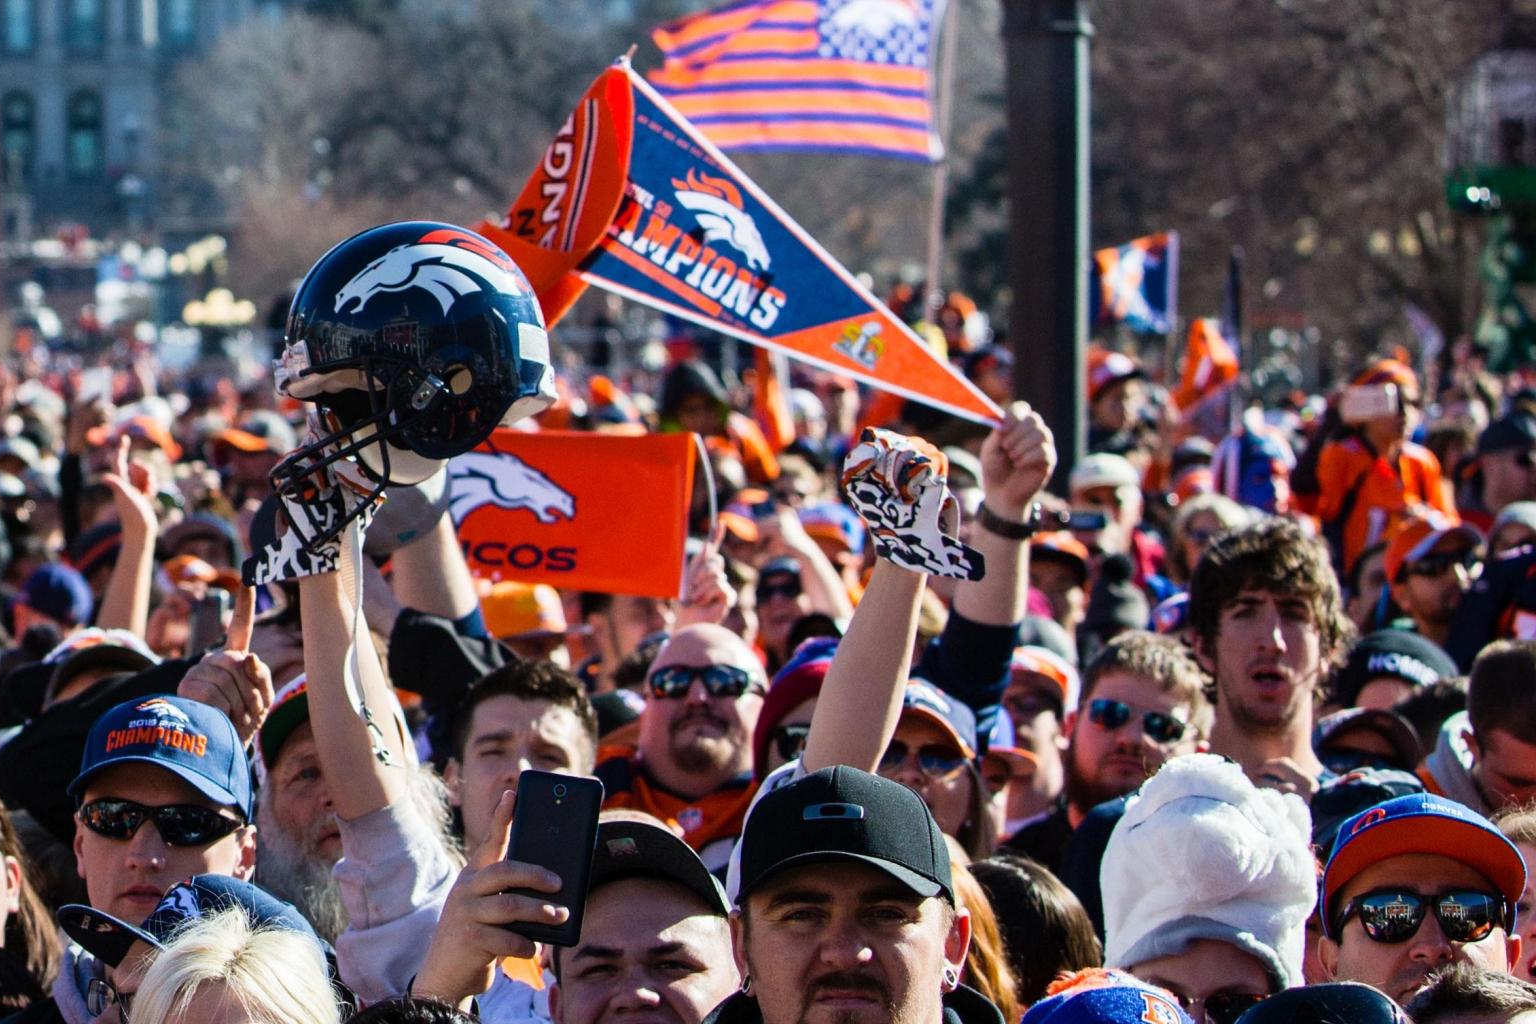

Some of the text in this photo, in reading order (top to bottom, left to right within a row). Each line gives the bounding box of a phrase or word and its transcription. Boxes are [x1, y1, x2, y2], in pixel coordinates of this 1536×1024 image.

[608, 201, 787, 330] AMPIONS
[106, 727, 207, 757] CHAMPIONS
[1421, 802, 1464, 817] DENVER
